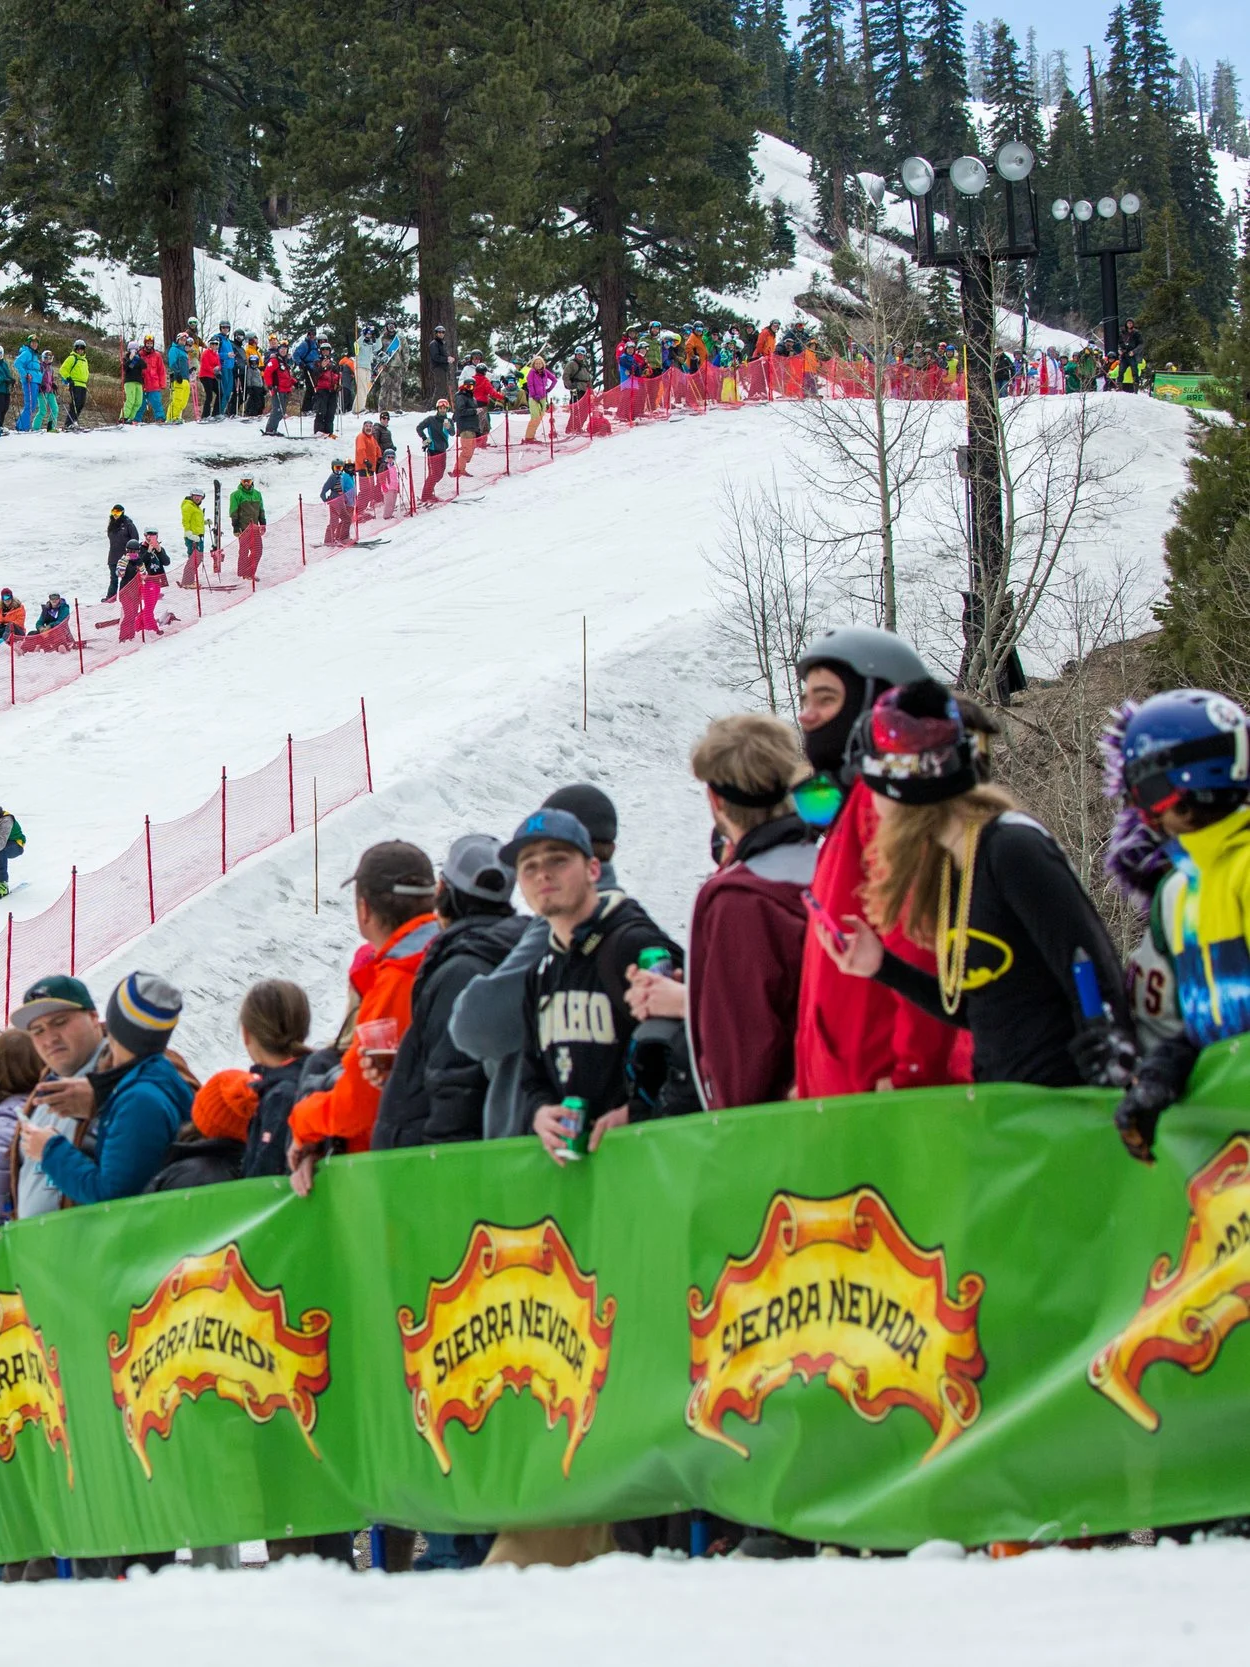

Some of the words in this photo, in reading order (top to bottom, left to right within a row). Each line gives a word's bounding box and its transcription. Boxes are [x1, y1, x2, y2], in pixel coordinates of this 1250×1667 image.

[130, 1321, 189, 1399] SIERRA
[433, 1302, 514, 1384] SIERRA
[519, 1295, 587, 1382] NEVADA
[720, 1282, 820, 1371] SIERRA
[828, 1275, 927, 1371] NEVADA
